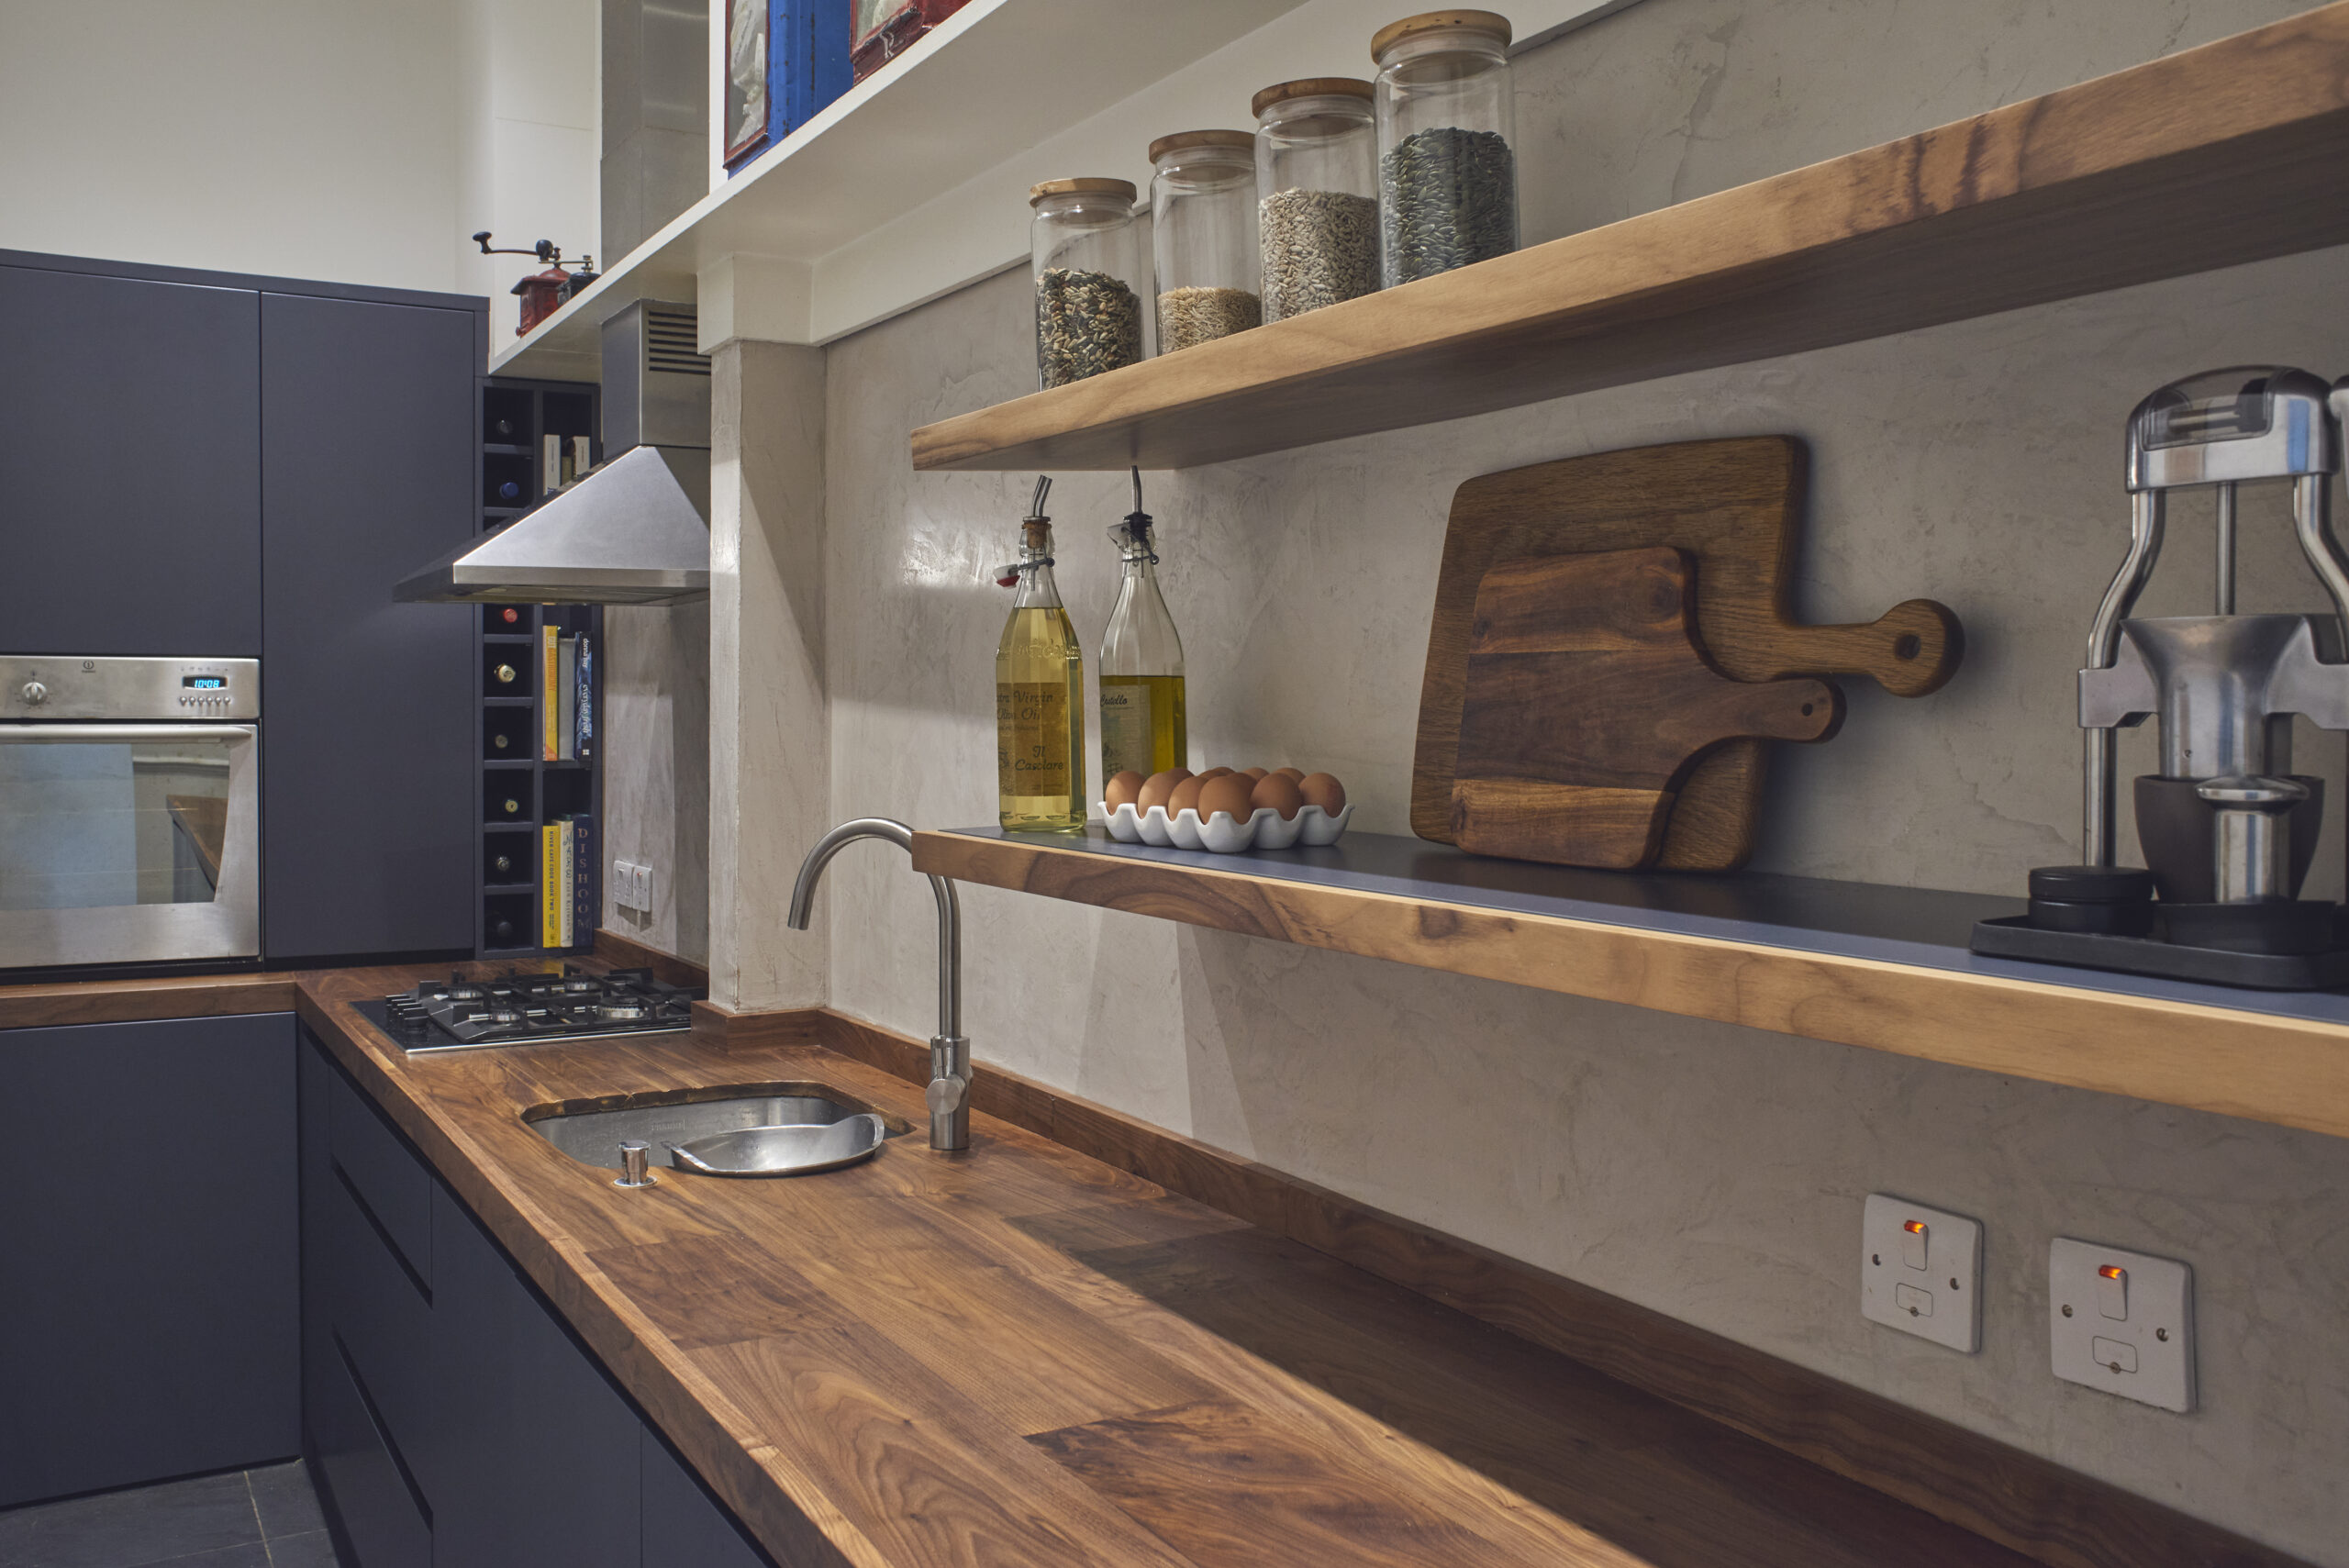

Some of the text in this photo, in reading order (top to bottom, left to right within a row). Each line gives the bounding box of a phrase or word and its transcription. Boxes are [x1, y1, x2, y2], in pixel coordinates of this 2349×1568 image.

[195, 679, 220, 688] 10:08
[1013, 690, 1054, 706] Virgin
[1015, 758, 1064, 772] Casolare
[577, 828, 593, 929] DISHOOM
